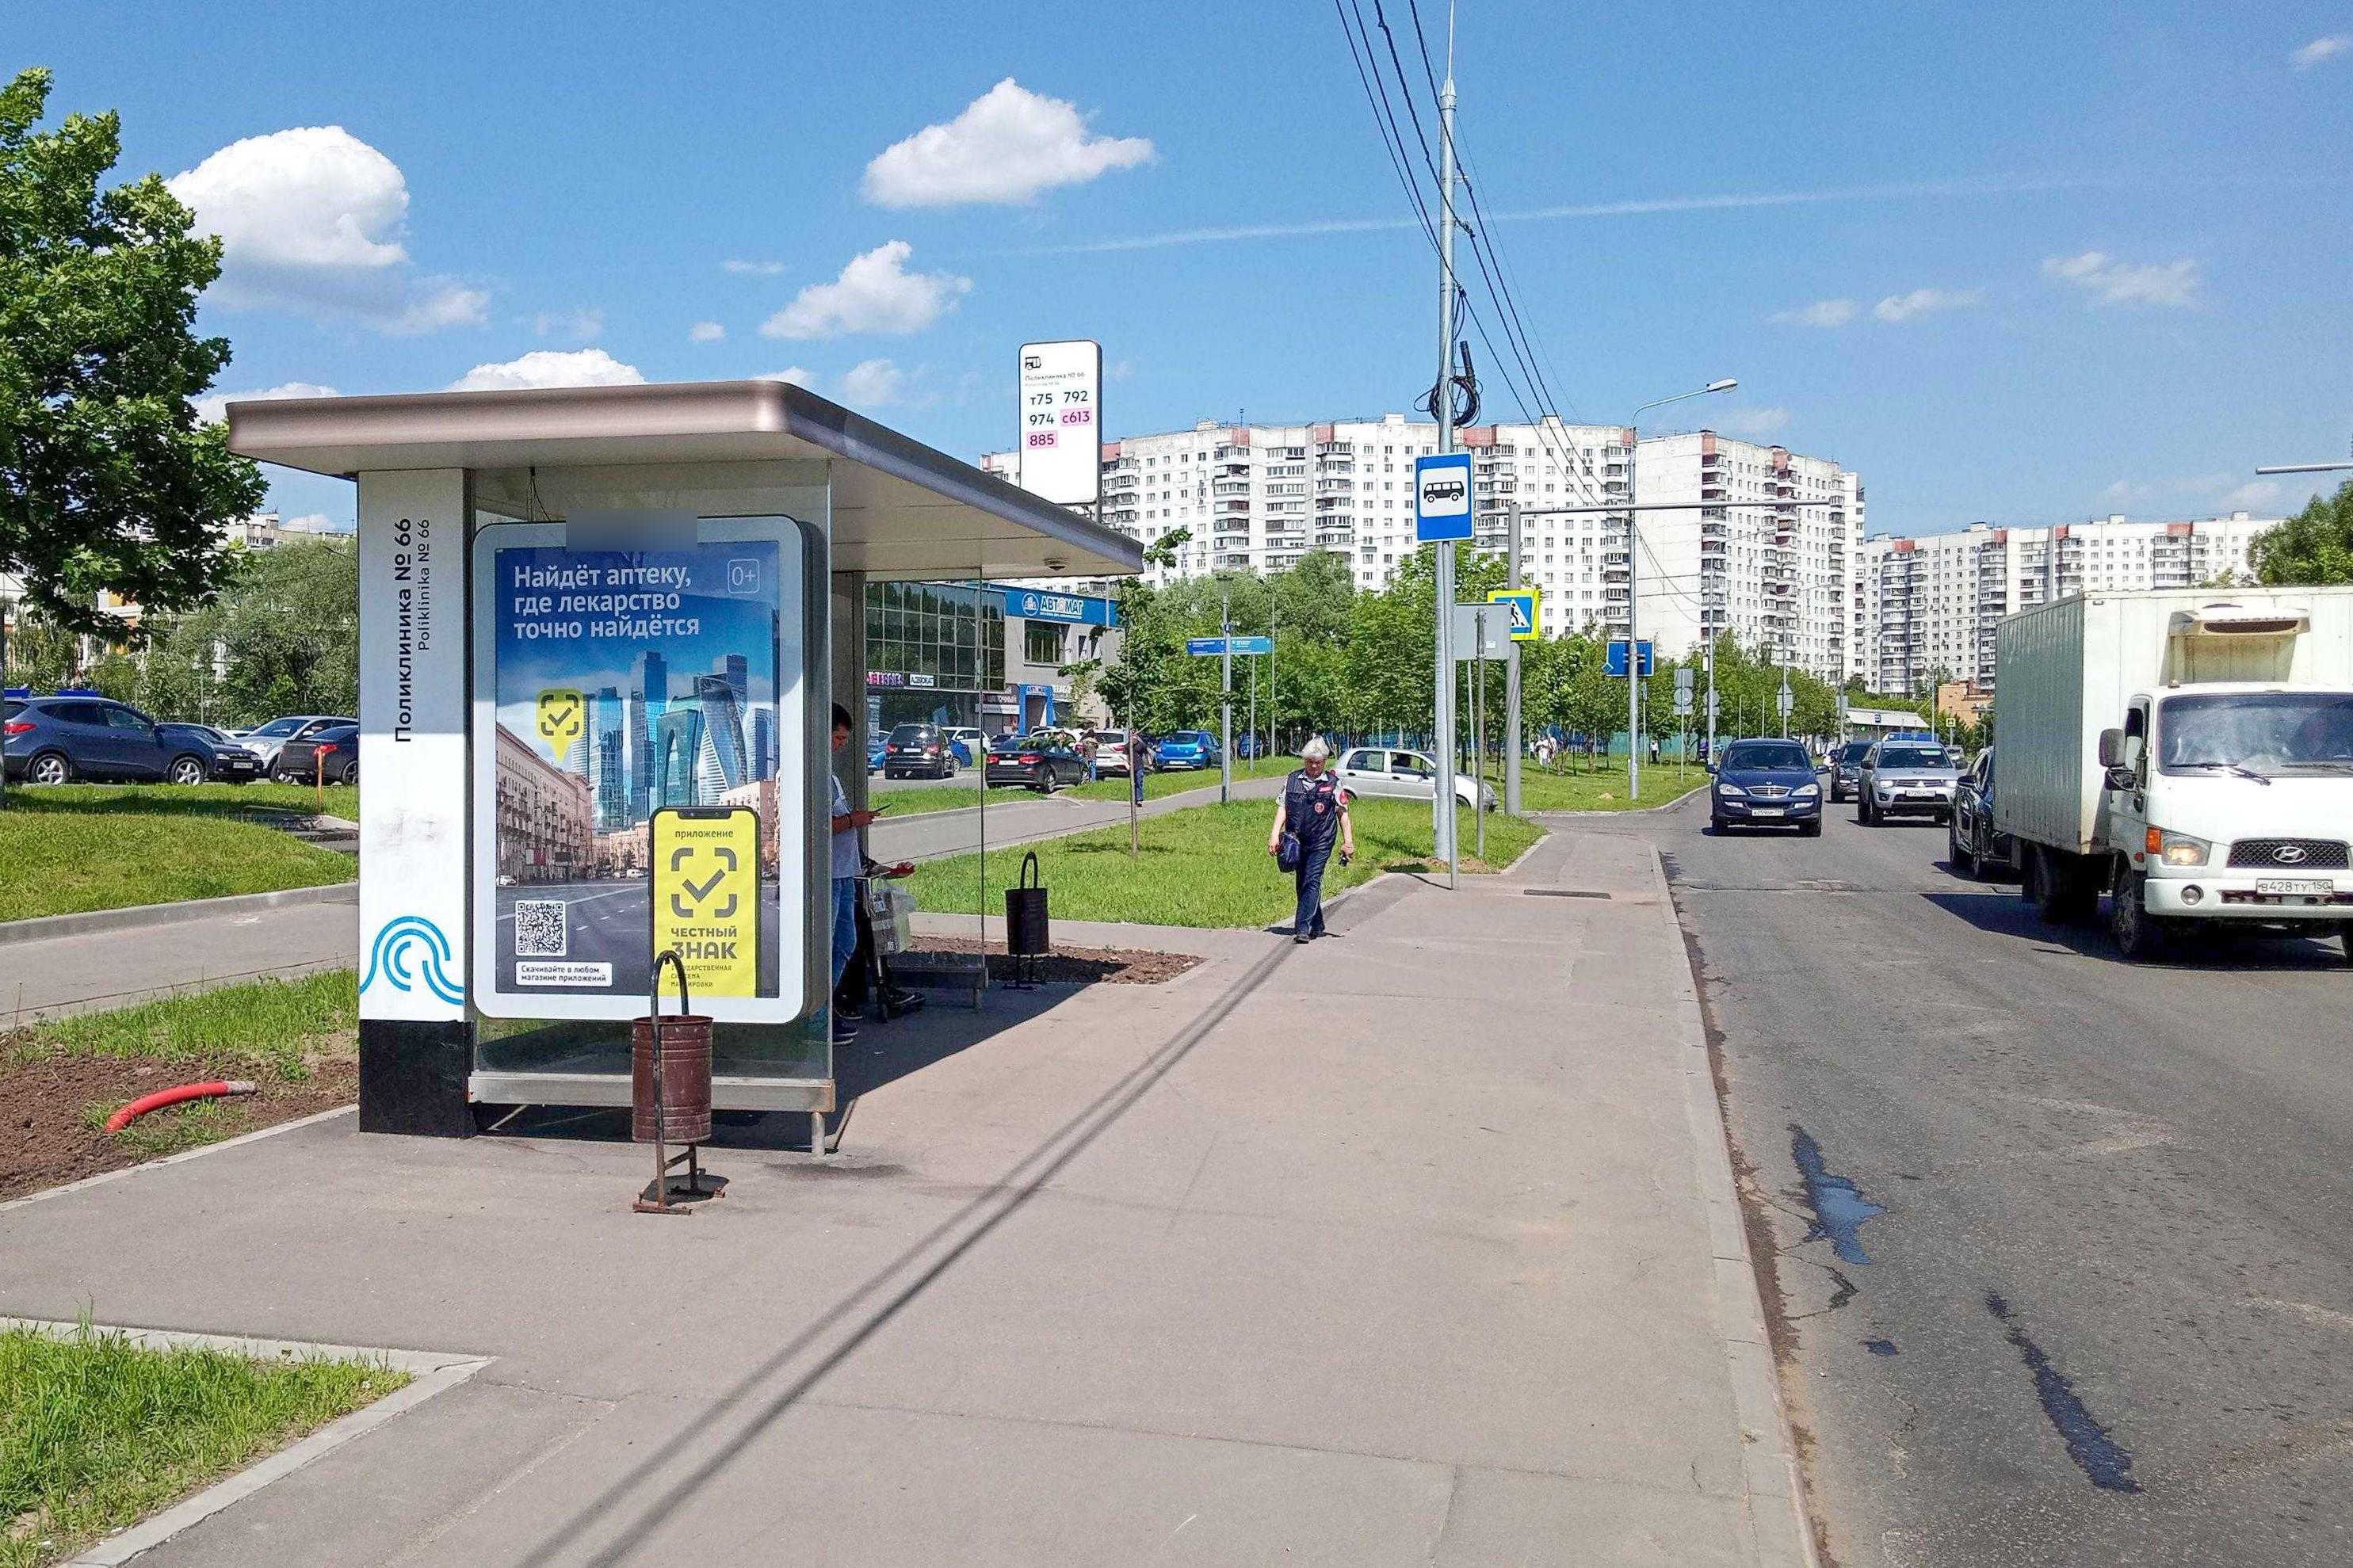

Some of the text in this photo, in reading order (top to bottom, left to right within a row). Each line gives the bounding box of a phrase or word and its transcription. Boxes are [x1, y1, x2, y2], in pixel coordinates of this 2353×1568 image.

[1030, 391, 1088, 406] т75 792
[1029, 410, 1090, 425] 974 с613
[1029, 433, 1054, 446] 885
[395, 518, 411, 547] 66
[418, 519, 430, 538] 66
[514, 564, 692, 589] Найдёт аптеку,
[731, 566, 756, 586] 0+
[418, 567, 430, 650] Poliklinika
[514, 593, 681, 616] где лекарство
[514, 614, 700, 639] точно найдётся
[395, 589, 411, 742] Поликлиника
[675, 830, 734, 840] приложение
[670, 925, 738, 937] ЧЕСТНЫЙ
[671, 941, 738, 959] ЗНАК
[521, 964, 566, 973] Скачивайте
